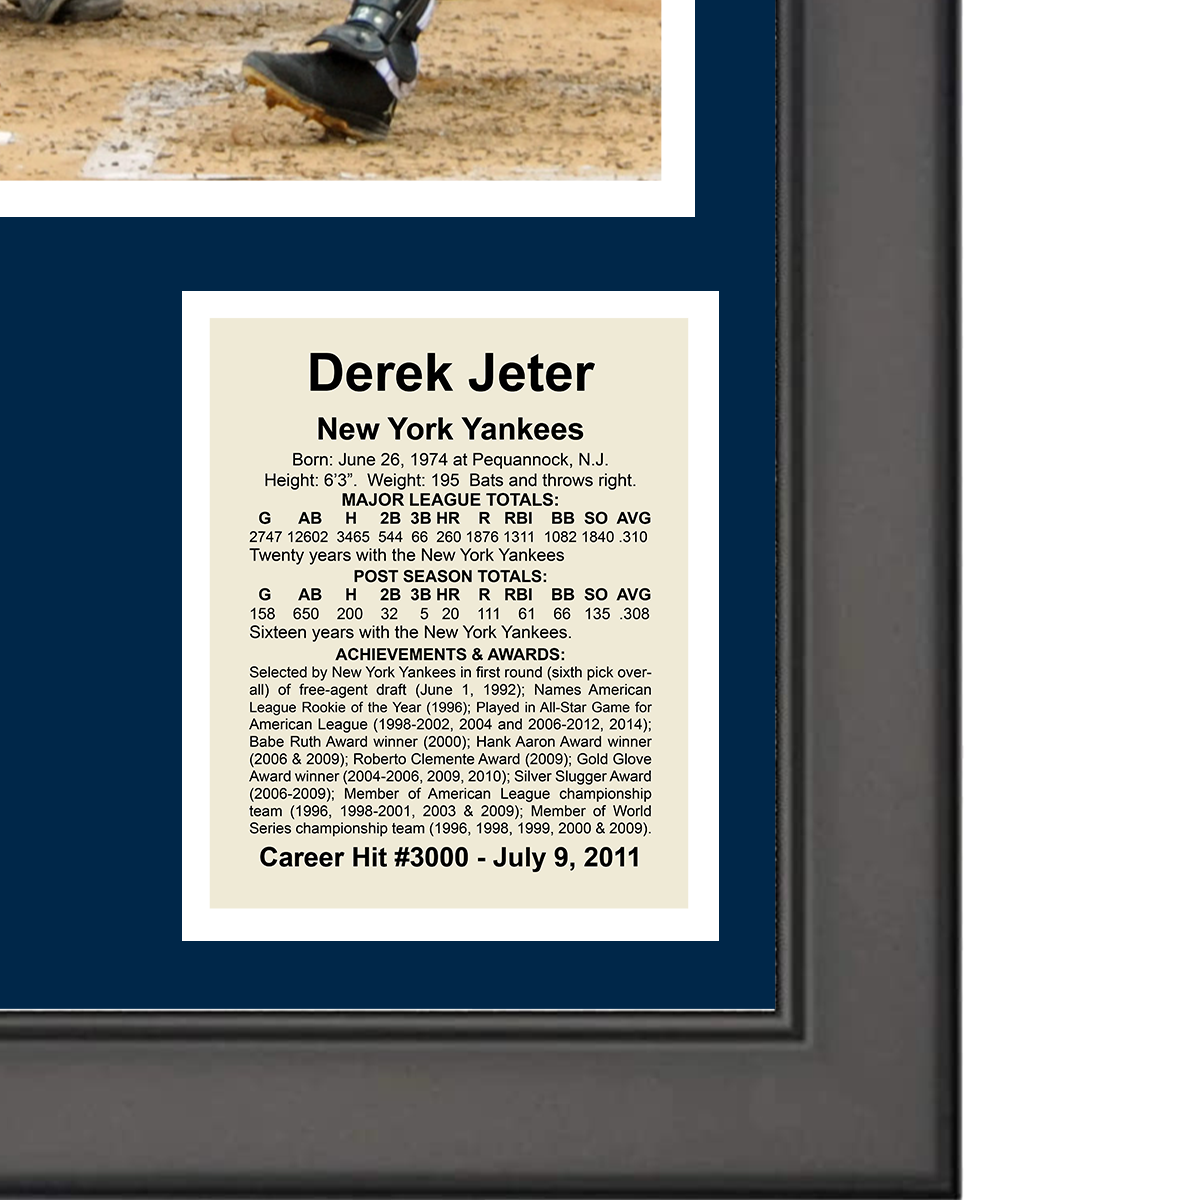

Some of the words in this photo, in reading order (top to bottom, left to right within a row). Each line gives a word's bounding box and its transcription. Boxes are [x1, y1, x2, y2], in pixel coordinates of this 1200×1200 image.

[309, 352, 454, 393] Derek
[468, 352, 596, 393] Jeter
[317, 416, 381, 441] New
[387, 416, 454, 441] York
[461, 416, 584, 441] Yankees
[292, 452, 333, 467] Born:
[338, 452, 376, 467] June
[380, 452, 405, 469] 26,
[410, 452, 449, 467] 1974
[452, 452, 468, 467] at
[472, 452, 573, 470] Pequannock,
[578, 452, 609, 467] N.J.
[264, 472, 319, 491] Height:
[366, 472, 425, 491] Weight:
[431, 472, 460, 487] 195
[469, 472, 504, 487] Bats
[508, 472, 538, 487] and
[541, 472, 594, 487] throws
[598, 472, 636, 491] right.
[341, 492, 405, 507] MAJOR
[409, 492, 482, 507] LEAGUE
[485, 492, 559, 507] TOTALS:
[258, 511, 272, 525] G
[297, 511, 323, 525] AB
[345, 511, 357, 525] H
[380, 511, 402, 525] 2B
[410, 511, 432, 525] 3B
[436, 511, 461, 525] HR
[478, 511, 491, 525] R
[504, 511, 533, 525] RBI
[551, 511, 575, 525] BB
[584, 511, 608, 525] SO
[616, 511, 651, 525] AVG
[249, 530, 283, 543] 2747
[287, 530, 329, 543] 12602
[336, 530, 370, 543] 3465
[378, 530, 404, 543] 544
[411, 530, 429, 543] 66
[436, 530, 462, 543] 260
[466, 530, 499, 543] 1876
[503, 530, 534, 543] 1311
[544, 530, 577, 543] 1082
[581, 530, 615, 543] 1840
[619, 530, 648, 543] .310
[249, 547, 305, 566] Twenty
[308, 550, 352, 566] years
[355, 547, 387, 562] with
[391, 547, 416, 562] the
[421, 547, 456, 562] New
[459, 547, 495, 562] York
[498, 547, 565, 562] Yankees
[353, 569, 399, 583] POST
[402, 569, 473, 583] SEASON
[477, 569, 547, 583] TOTALS:
[258, 587, 272, 602] G
[297, 587, 323, 601] AB
[345, 587, 357, 601] H
[379, 587, 402, 601] 2B
[410, 587, 432, 602] 3B
[436, 587, 461, 601] HR
[478, 587, 491, 601] R
[504, 587, 533, 601] RBI
[551, 587, 575, 601] BB
[584, 587, 608, 602] SO
[616, 587, 652, 602] AVG
[250, 607, 276, 620] 158
[292, 607, 320, 620] 650
[336, 607, 364, 620] 200
[380, 607, 398, 620] 32
[420, 607, 429, 620] 5
[441, 607, 460, 620] 20
[477, 607, 499, 620] 111
[518, 607, 534, 620] 61
[553, 607, 571, 620] 66
[585, 607, 611, 620] 135
[619, 607, 650, 620] .308
[334, 647, 467, 661] ACHIEVEMENTS
[471, 647, 484, 661] &
[487, 647, 565, 661] AWARDS:
[249, 665, 308, 679] Selected
[311, 665, 328, 682] by
[332, 665, 362, 679] New
[365, 665, 396, 679] York
[398, 665, 457, 679] Yankees
[460, 665, 472, 678] in
[475, 665, 501, 679] first
[504, 665, 543, 679] round
[547, 665, 583, 681] (sixth
[586, 665, 614, 682] pick
[617, 668, 652, 679] over-
[249, 701, 297, 716] League
[302, 701, 346, 714] Rookie
[350, 700, 364, 714] of
[367, 701, 388, 714] the
[392, 701, 422, 714] Year
[426, 701, 471, 716] (1996);
[476, 701, 520, 716] Played
[524, 701, 536, 713] in
[539, 700, 588, 714] All-Star
[591, 700, 631, 714] Game
[634, 700, 653, 714] for
[249, 735, 285, 748] Babe
[290, 735, 322, 748] Ruth
[325, 735, 368, 748] Award
[372, 735, 419, 748] winner
[423, 735, 471, 751] (2000);
[476, 735, 512, 748] Hank
[514, 735, 556, 748] Aaron
[559, 735, 602, 748] Award
[607, 735, 653, 748] winner
[249, 752, 288, 768] (2006
[291, 752, 302, 765] &
[306, 752, 349, 768] 2009);
[353, 752, 407, 765] Roberto
[410, 752, 475, 765] Clemente
[477, 752, 521, 765] Award
[525, 752, 572, 768] (2009);
[576, 752, 608, 765] Gold
[612, 752, 652, 765] Glove
[248, 805, 283, 817] team
[290, 804, 332, 820] (1996,
[340, 804, 415, 819] 1998-2001,
[422, 804, 457, 817] 2003
[463, 804, 474, 817] &
[480, 804, 523, 820] 2009);
[531, 804, 587, 817] Member
[592, 804, 607, 817] of
[612, 804, 652, 817] World
[259, 846, 345, 868] Career
[352, 846, 388, 868] Hit
[394, 846, 469, 868] #3000
[492, 846, 547, 873] July
[553, 846, 576, 872] 9,
[583, 846, 639, 868] 2011
